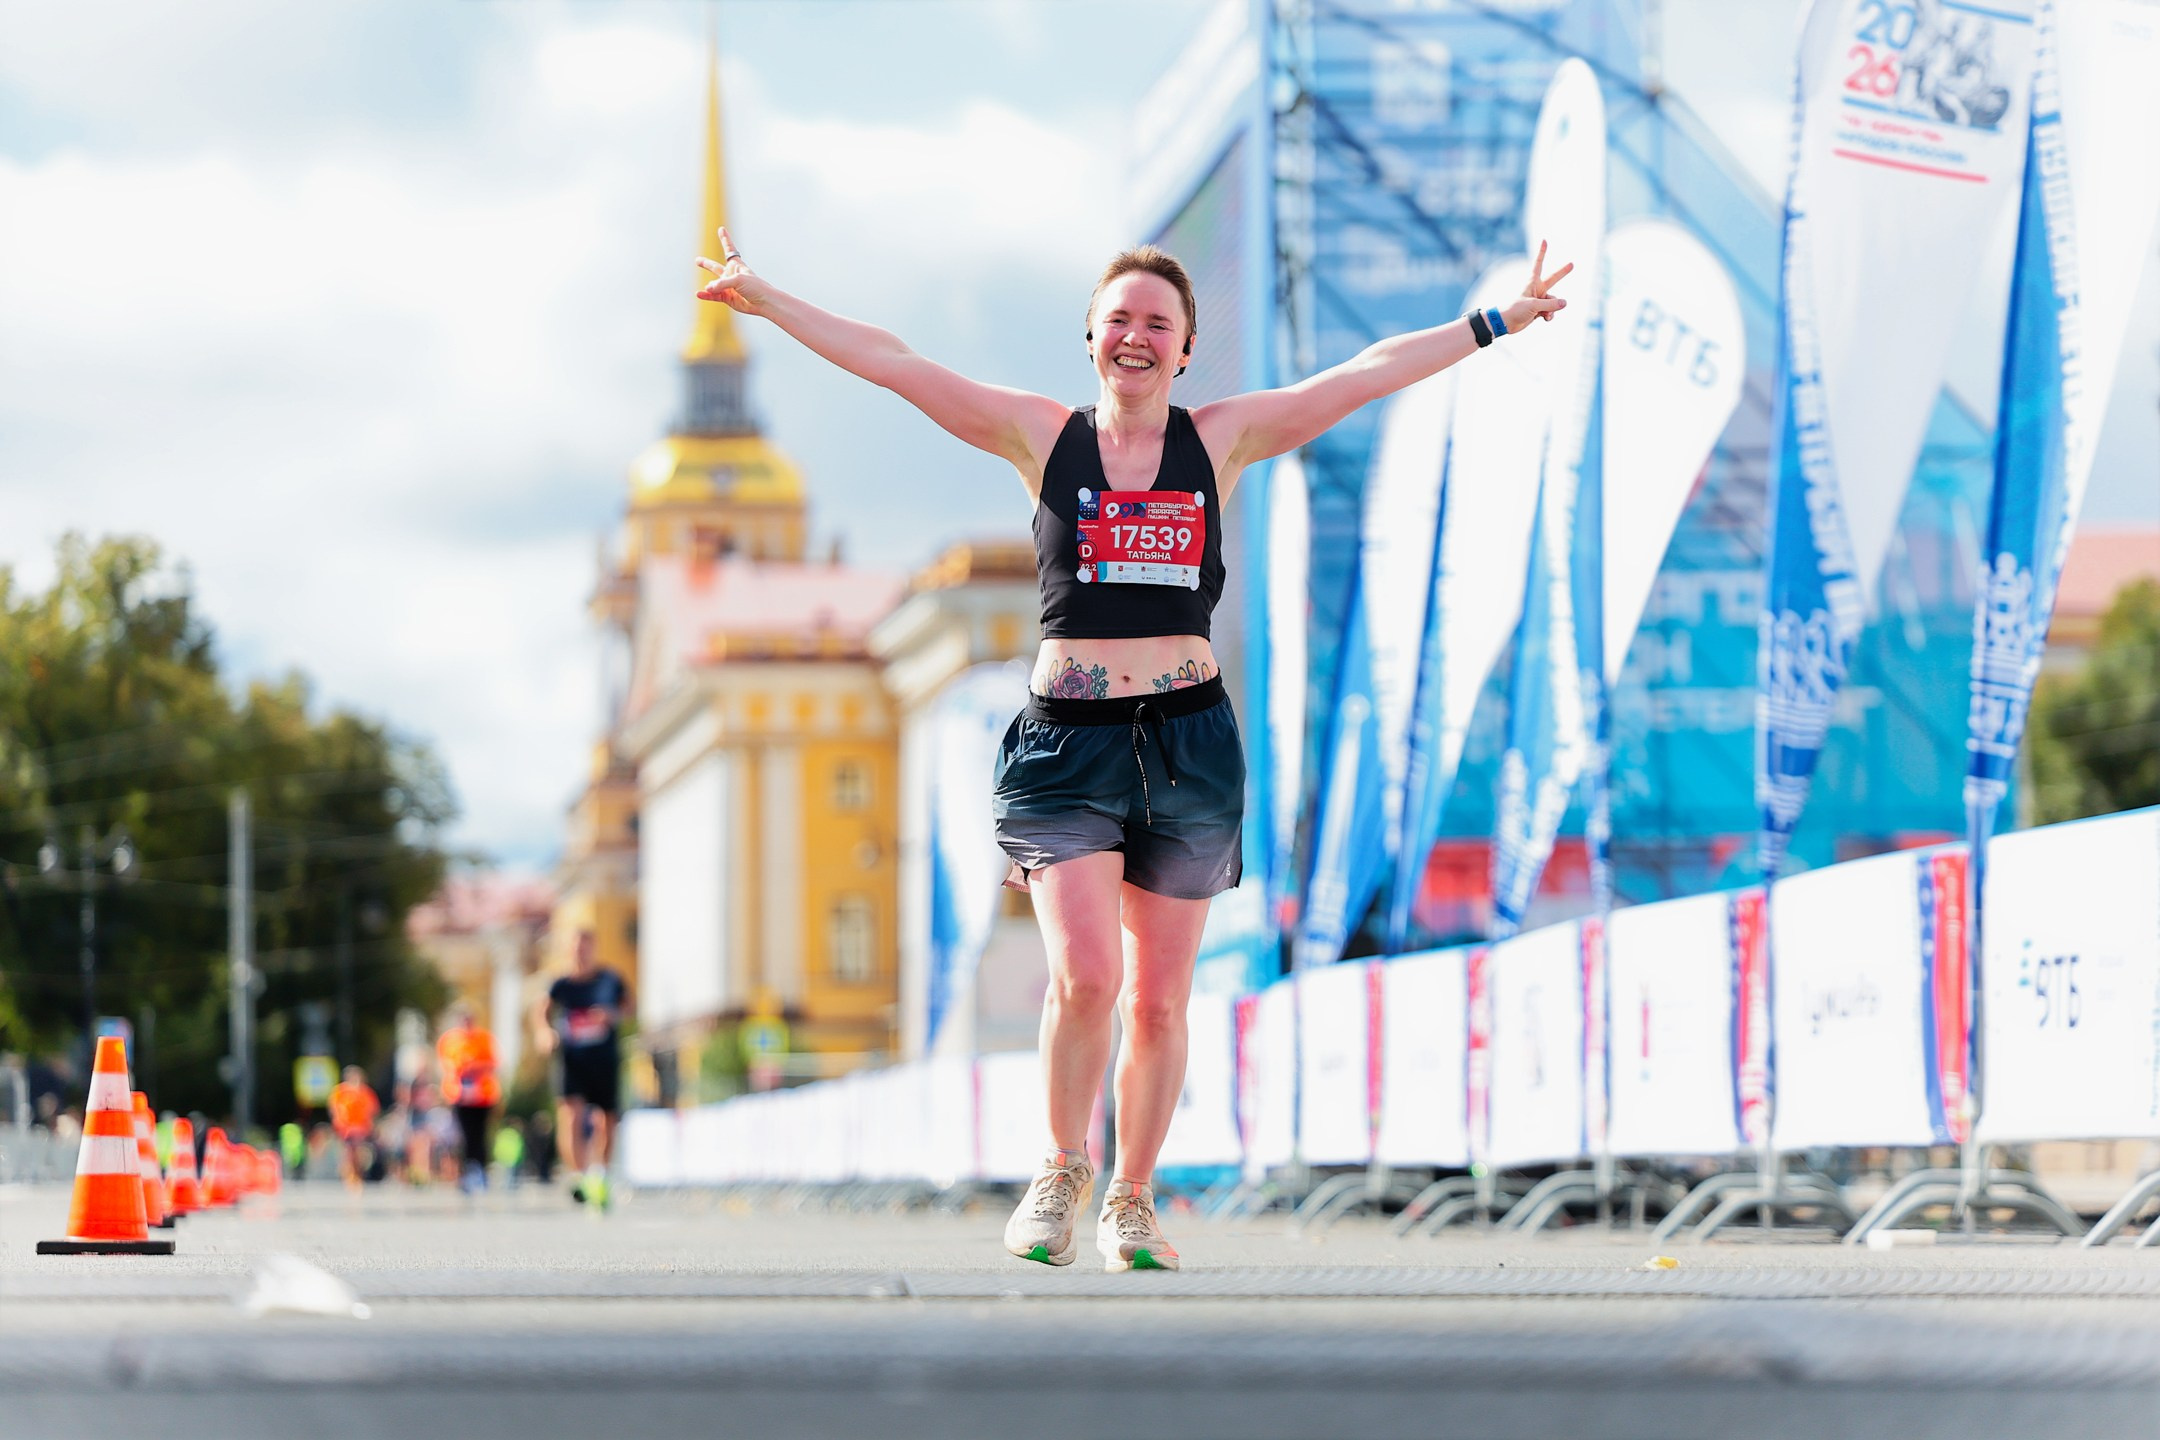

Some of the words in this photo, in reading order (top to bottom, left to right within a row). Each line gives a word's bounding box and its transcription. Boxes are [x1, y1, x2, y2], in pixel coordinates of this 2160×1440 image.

[1856, 0, 1915, 50] 20
[1844, 43, 1899, 97] 26
[1631, 299, 1721, 388] ВТБ
[1081, 545, 1093, 558] D
[1110, 525, 1192, 551] 17539
[1127, 551, 1172, 561] ТАТЬЯНА
